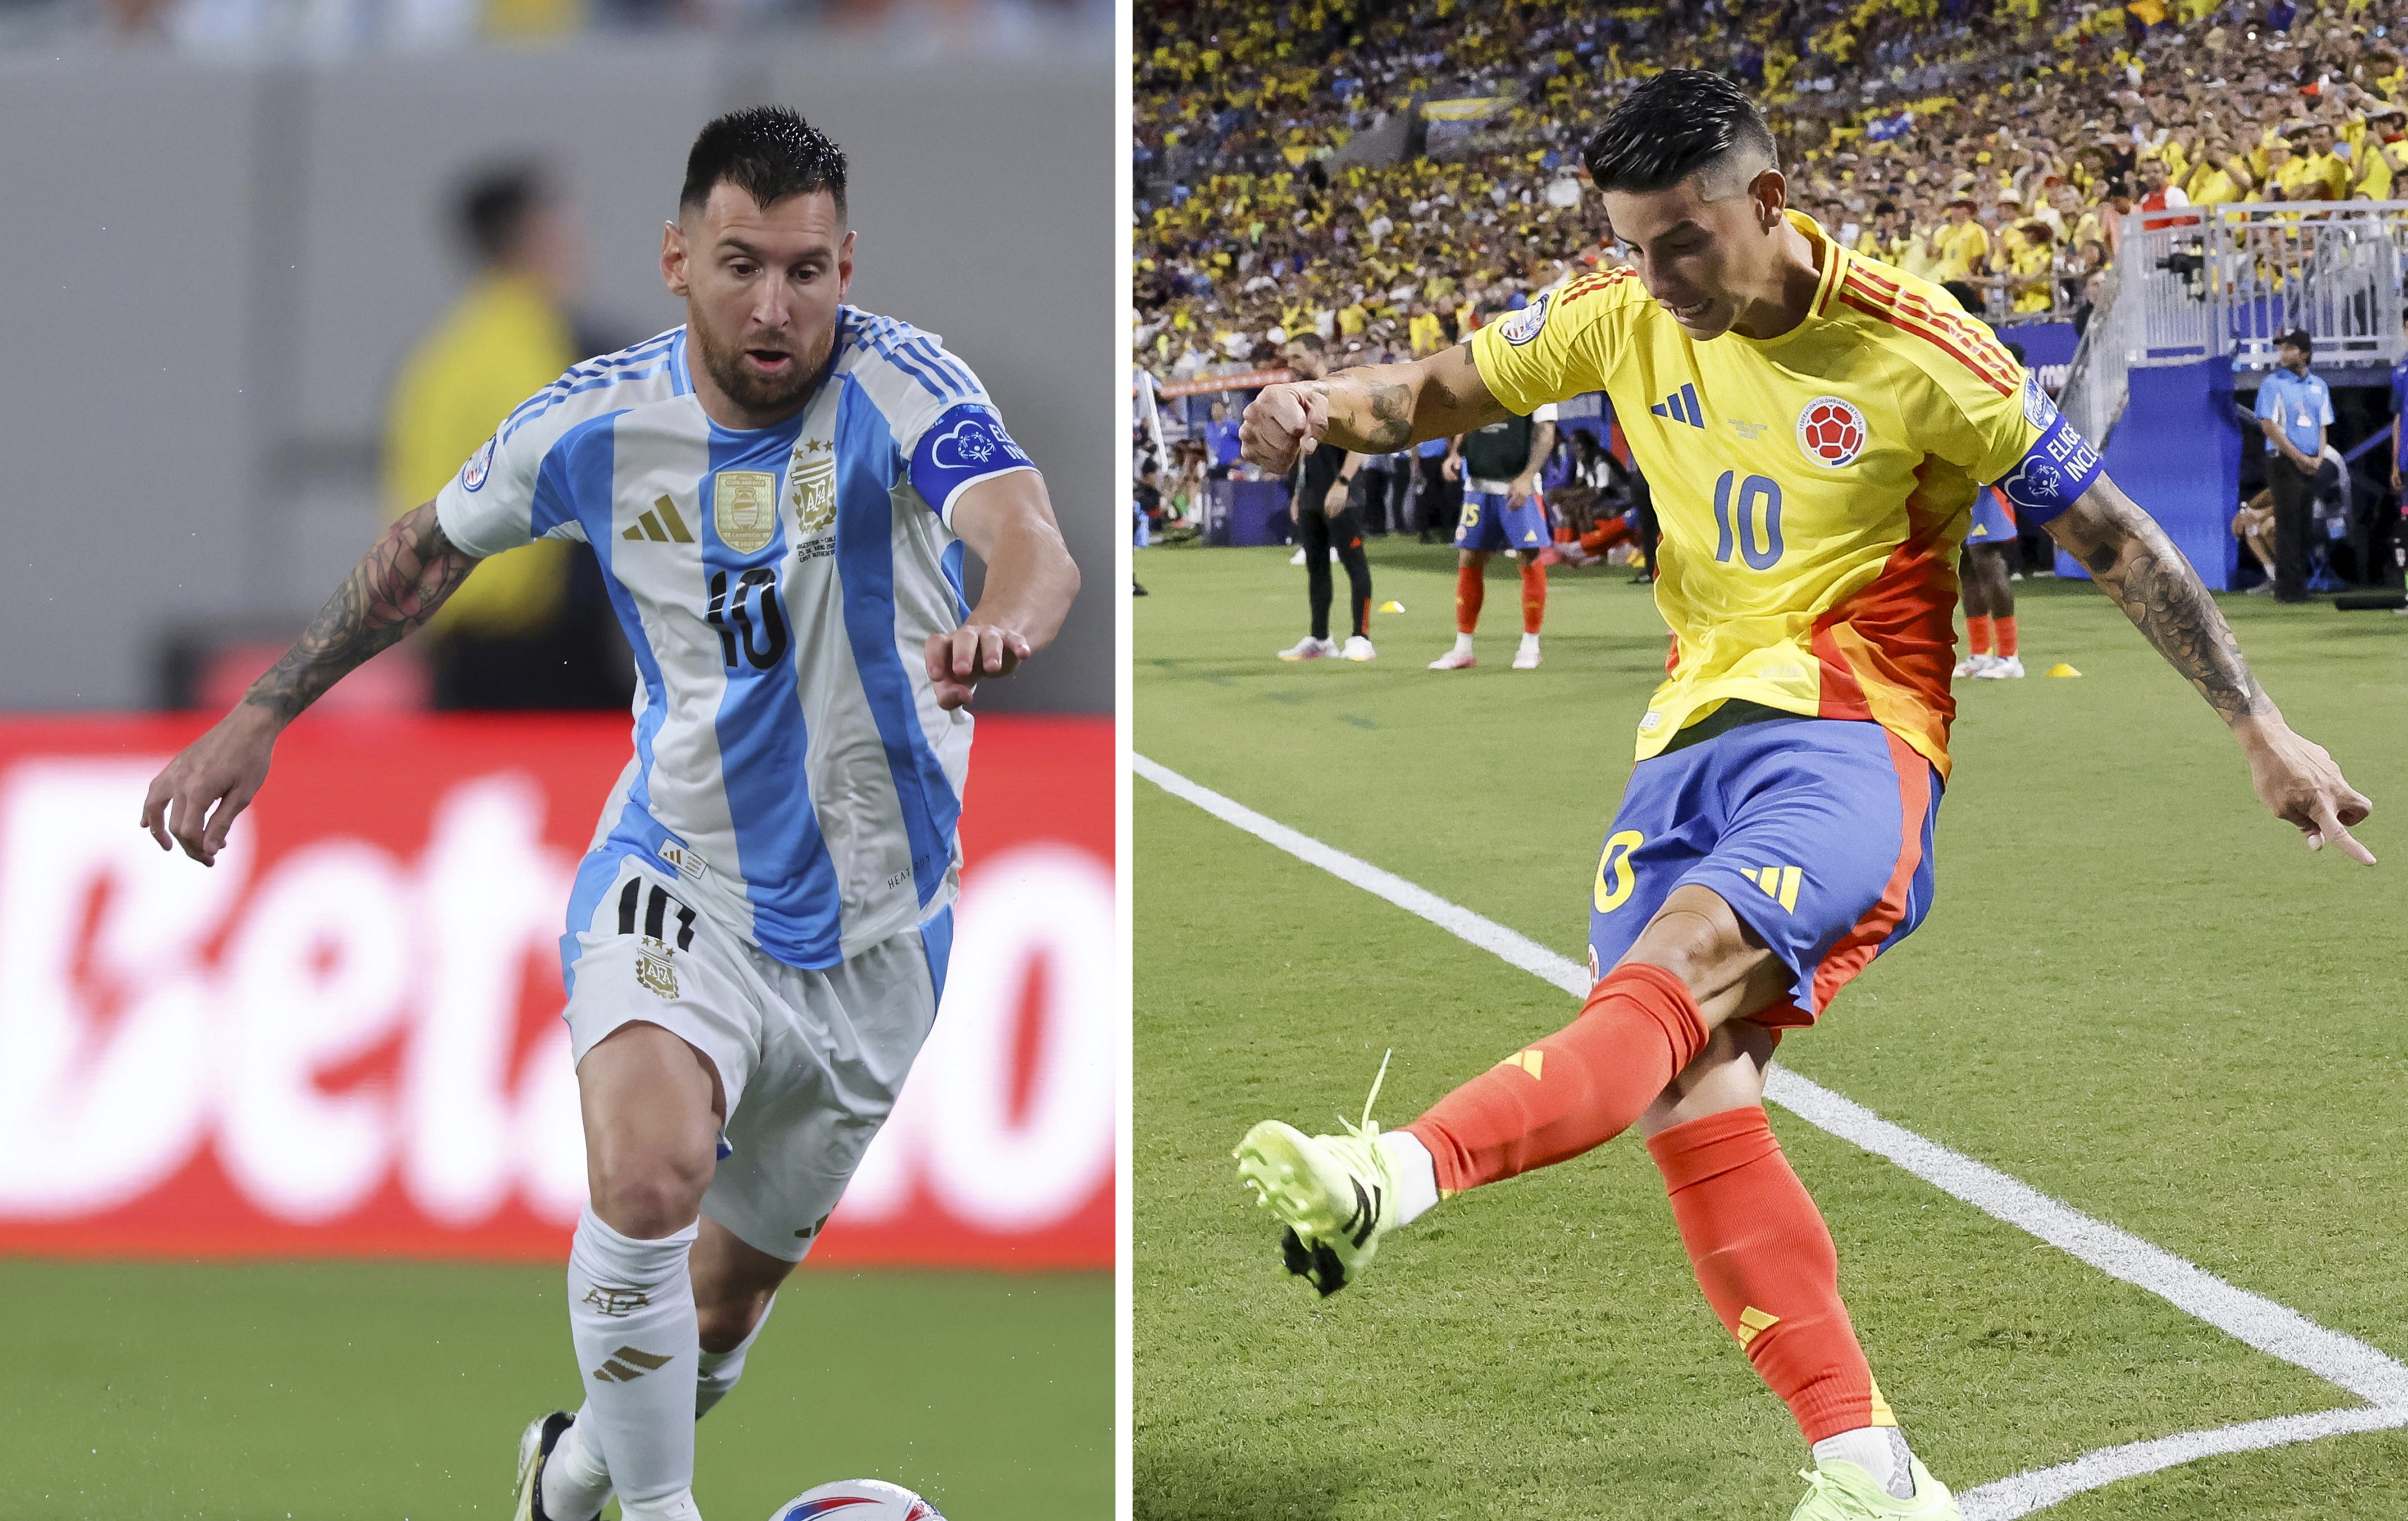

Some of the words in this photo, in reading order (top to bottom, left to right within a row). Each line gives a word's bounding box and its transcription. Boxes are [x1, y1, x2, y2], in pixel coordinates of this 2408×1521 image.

[1003, 445, 1034, 465] IN
[2063, 440, 2099, 482] INCLU
[806, 479, 826, 512] AFA
[1714, 470, 1784, 570] 10
[707, 567, 787, 670] 10
[888, 866, 911, 889] HEAT
[646, 961, 673, 985] AFA
